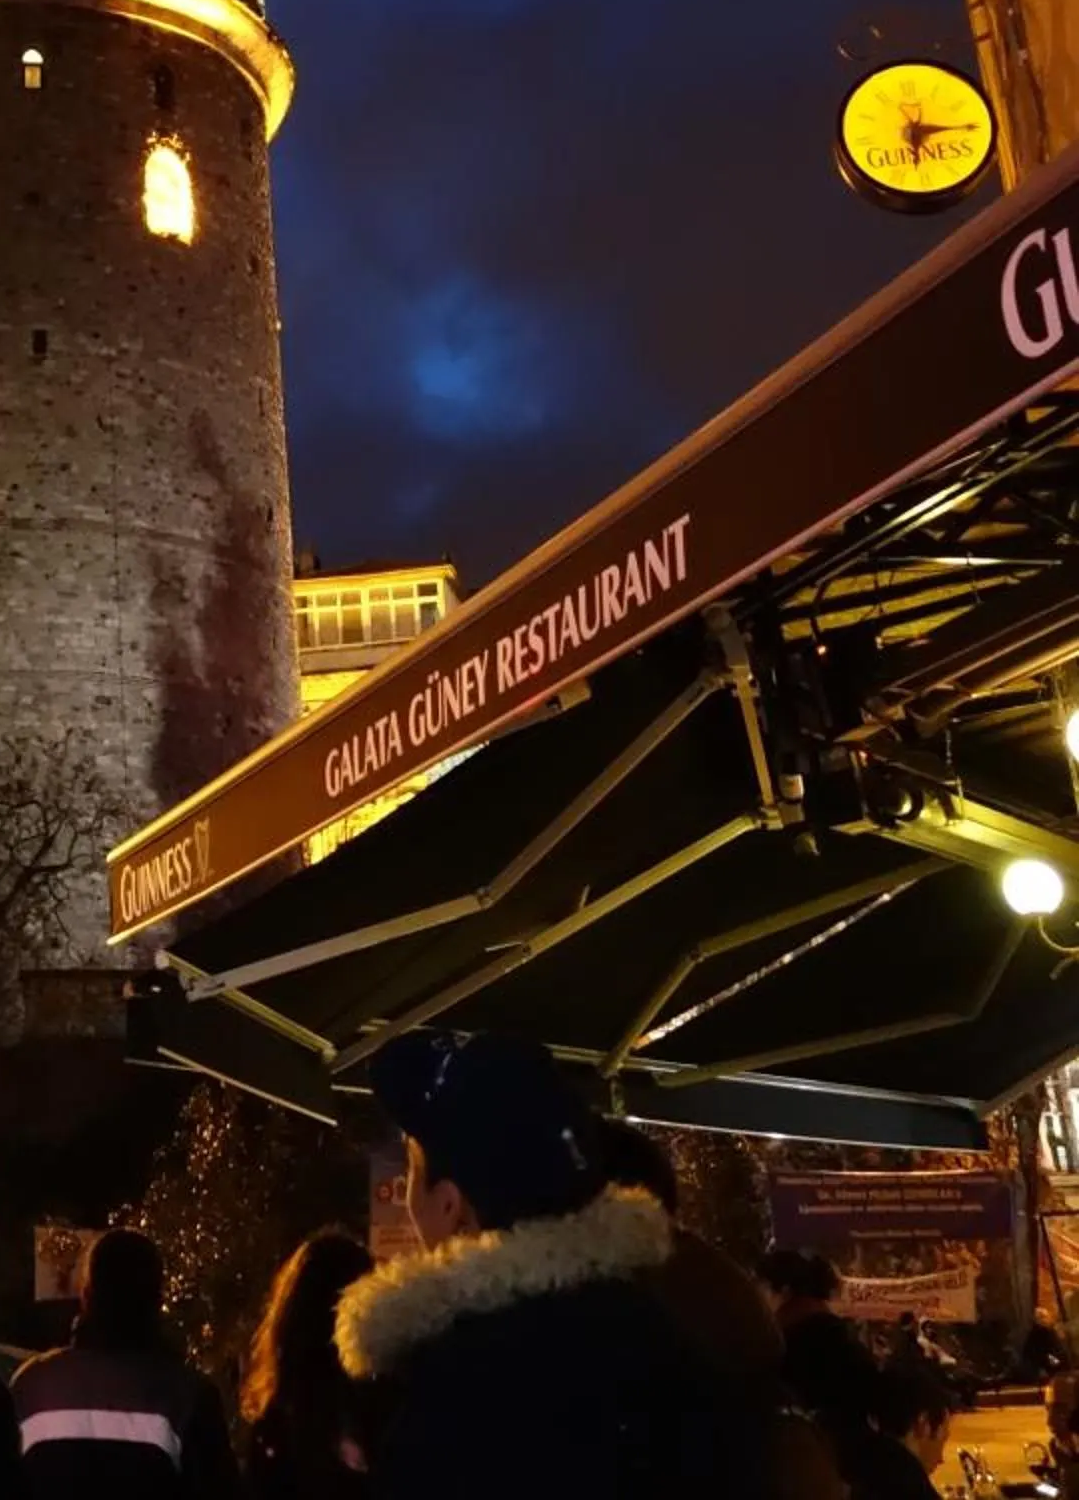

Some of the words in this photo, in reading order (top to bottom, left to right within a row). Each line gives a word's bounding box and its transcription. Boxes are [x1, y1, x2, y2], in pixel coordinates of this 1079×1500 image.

[325, 710, 402, 797] GALATA
[408, 648, 491, 748] GÜNEY
[497, 514, 691, 695] RESTAURANT
[120, 836, 193, 923] GUINNESS
